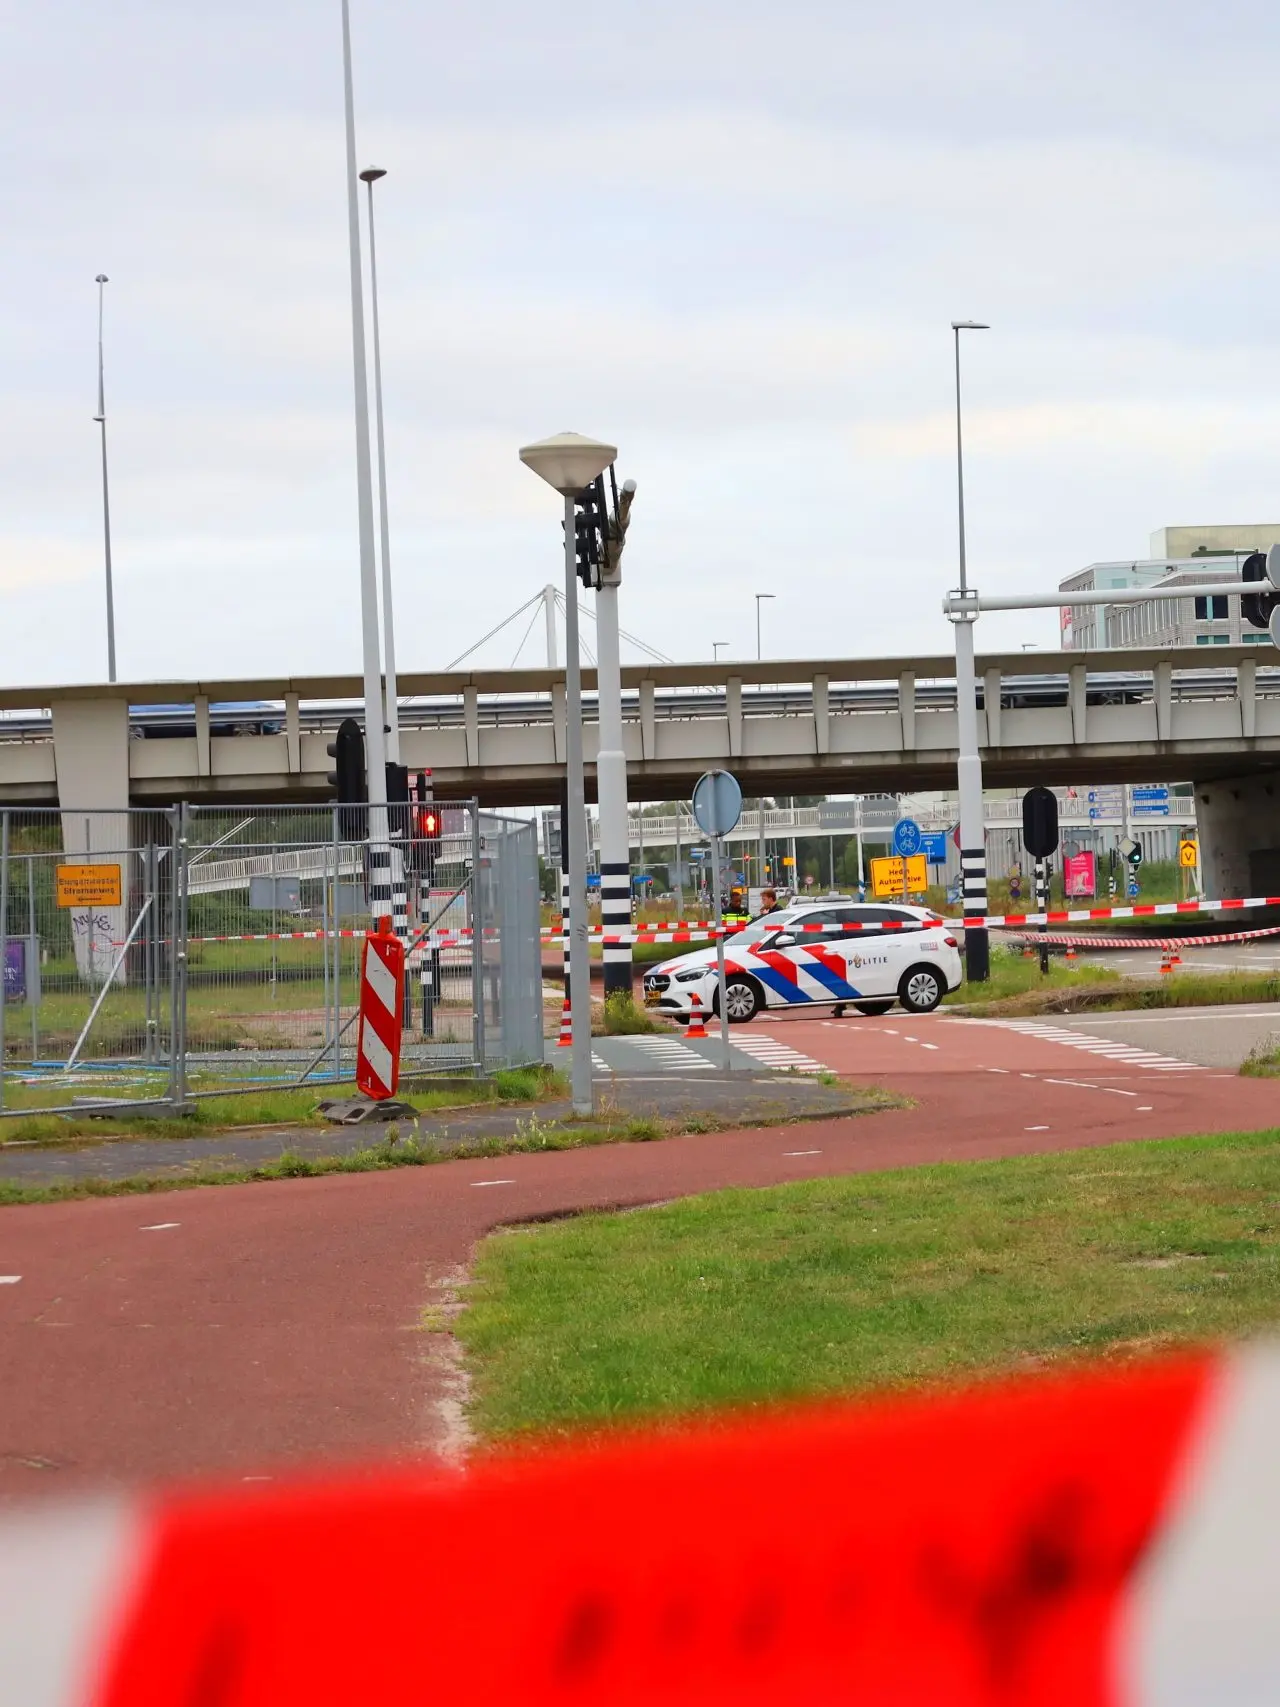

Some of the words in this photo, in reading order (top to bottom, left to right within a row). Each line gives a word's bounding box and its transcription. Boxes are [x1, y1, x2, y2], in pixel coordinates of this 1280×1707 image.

[889, 868, 910, 876] Hedn
[879, 876, 922, 886] Automtive
[848, 956, 888, 969] POLITIE
